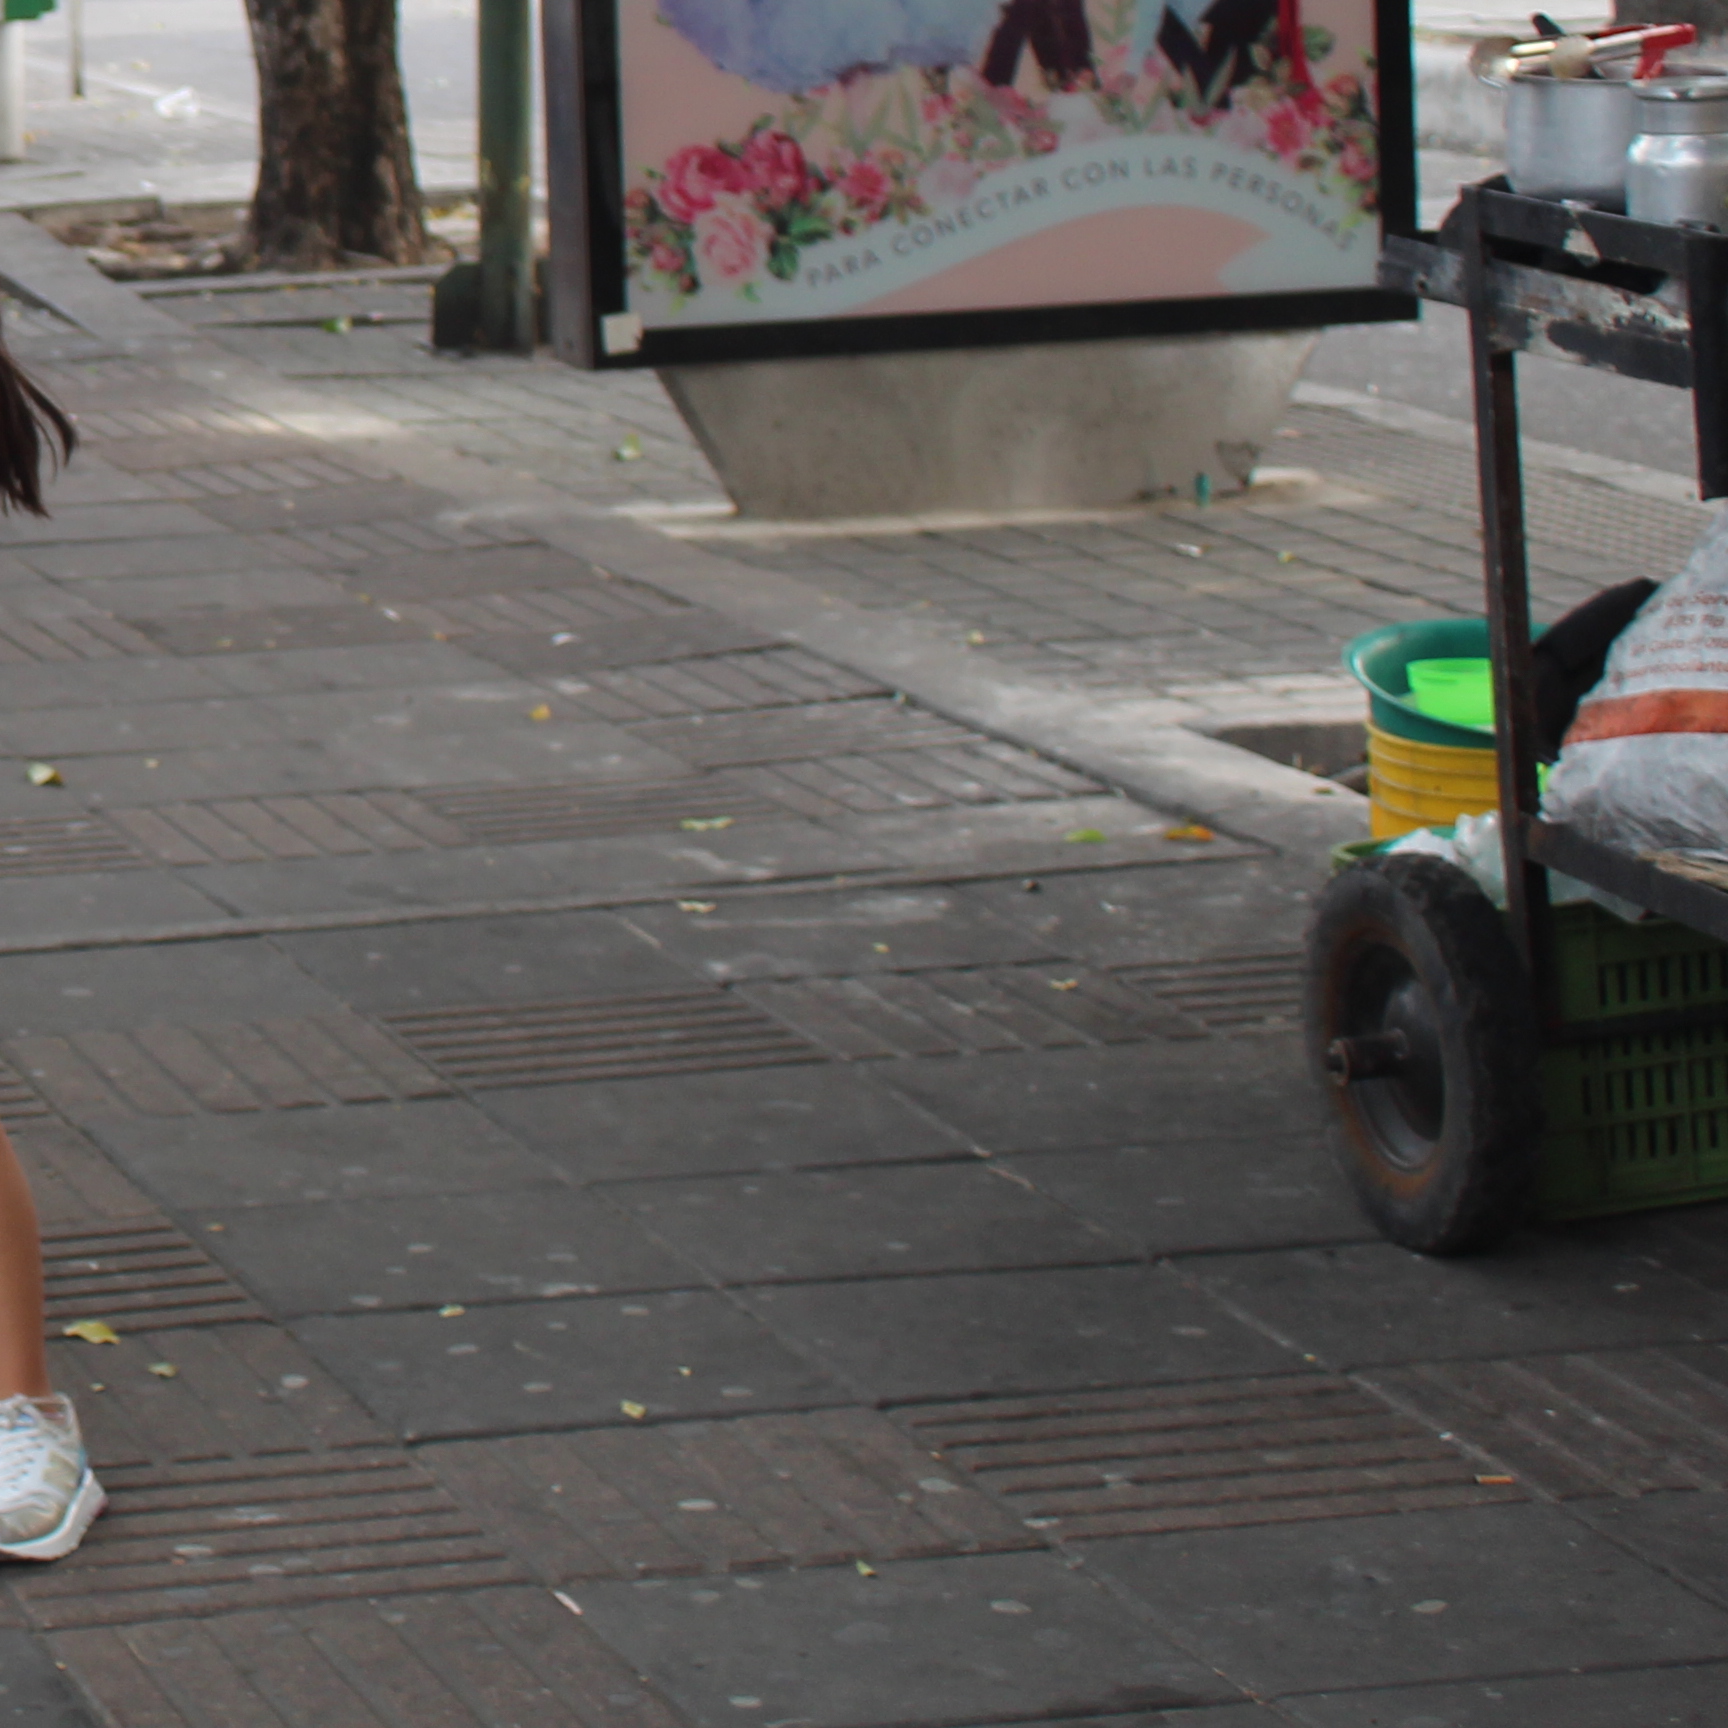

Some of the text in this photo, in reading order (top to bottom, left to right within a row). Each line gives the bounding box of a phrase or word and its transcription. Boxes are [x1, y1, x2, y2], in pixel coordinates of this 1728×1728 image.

[802, 156, 1360, 291] PARA CONECTAR CON LAS PERSONAS
